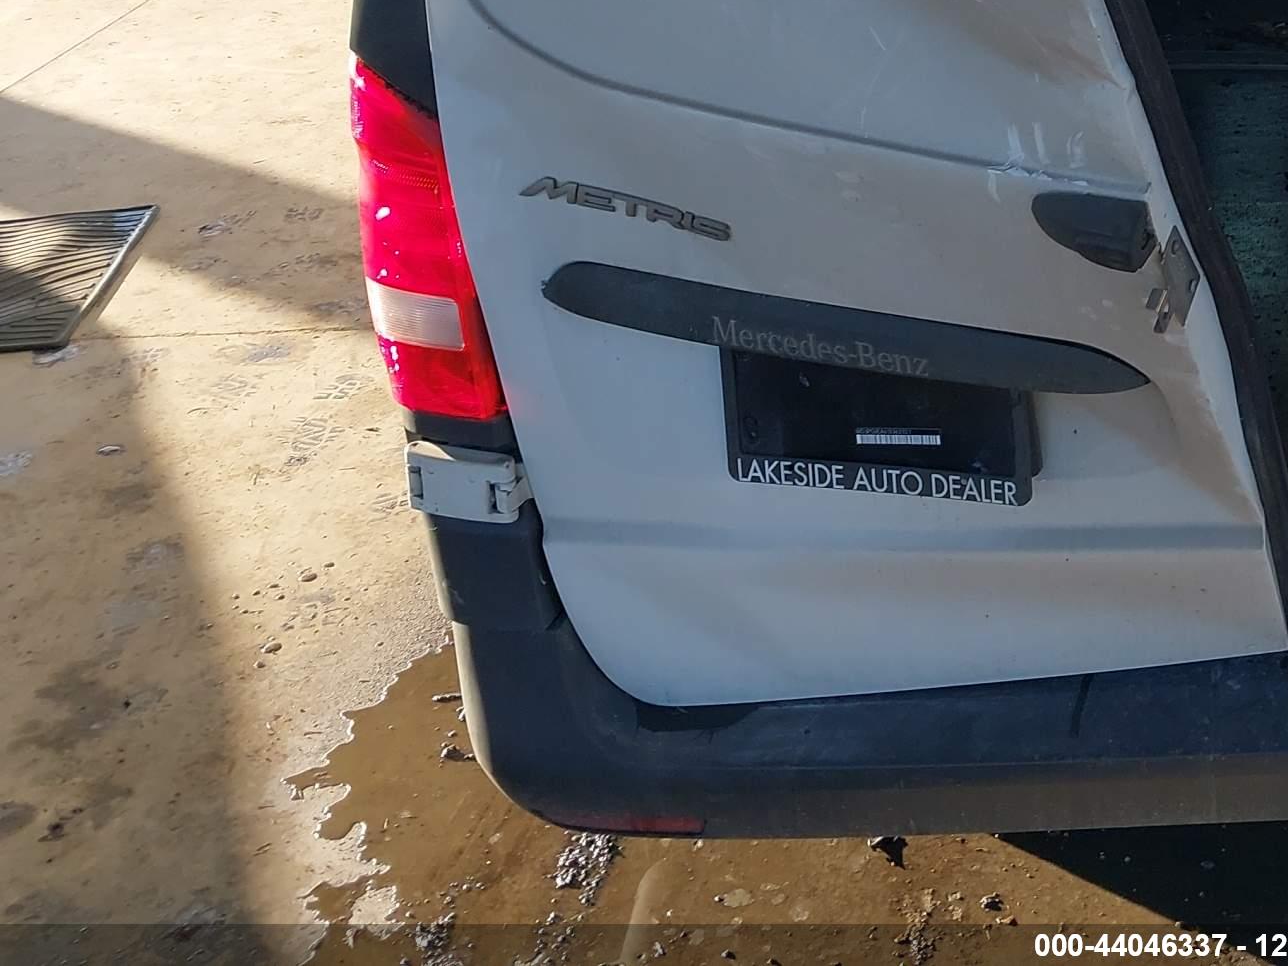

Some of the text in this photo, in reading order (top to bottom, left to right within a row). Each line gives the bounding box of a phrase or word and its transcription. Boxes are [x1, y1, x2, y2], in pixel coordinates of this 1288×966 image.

[518, 176, 731, 242] METRIS
[711, 315, 929, 377] Mercedes-Benz
[736, 457, 1018, 506] LAKESIDE AUTO DEALER
